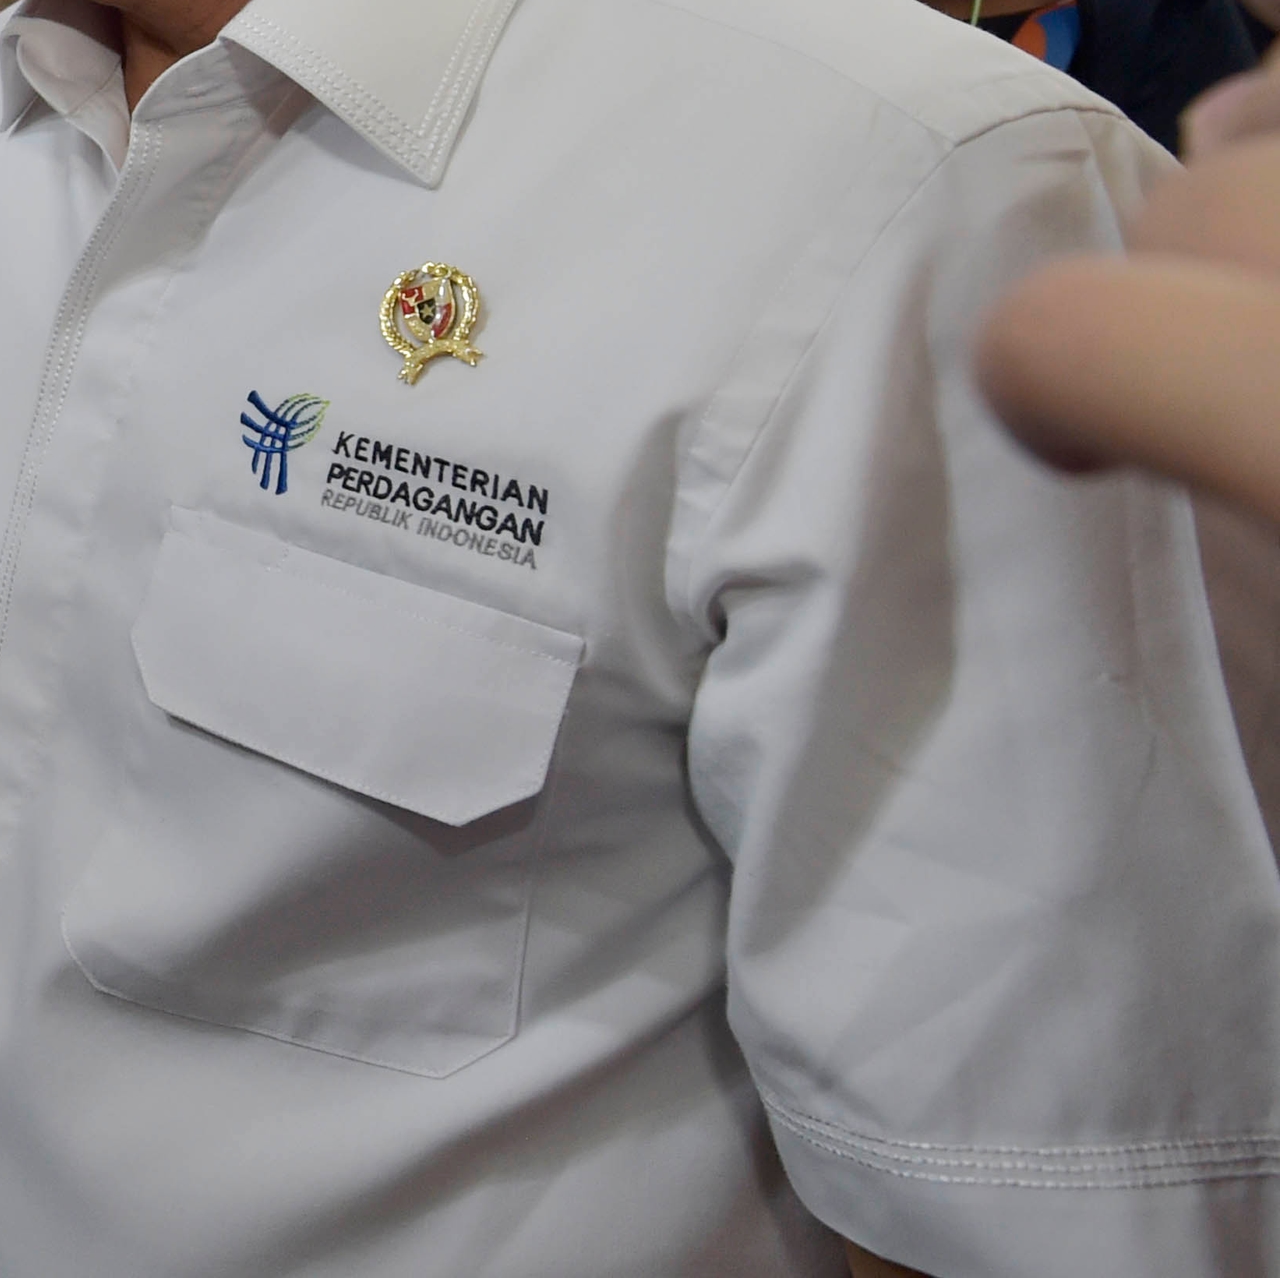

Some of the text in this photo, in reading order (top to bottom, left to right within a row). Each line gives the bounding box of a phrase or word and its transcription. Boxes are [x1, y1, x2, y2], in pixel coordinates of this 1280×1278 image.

[326, 463, 544, 546] PERDAGANGAN
[333, 431, 549, 515] KEMENTERIAN
[321, 489, 537, 570] REPUBLIK INDONESIA
